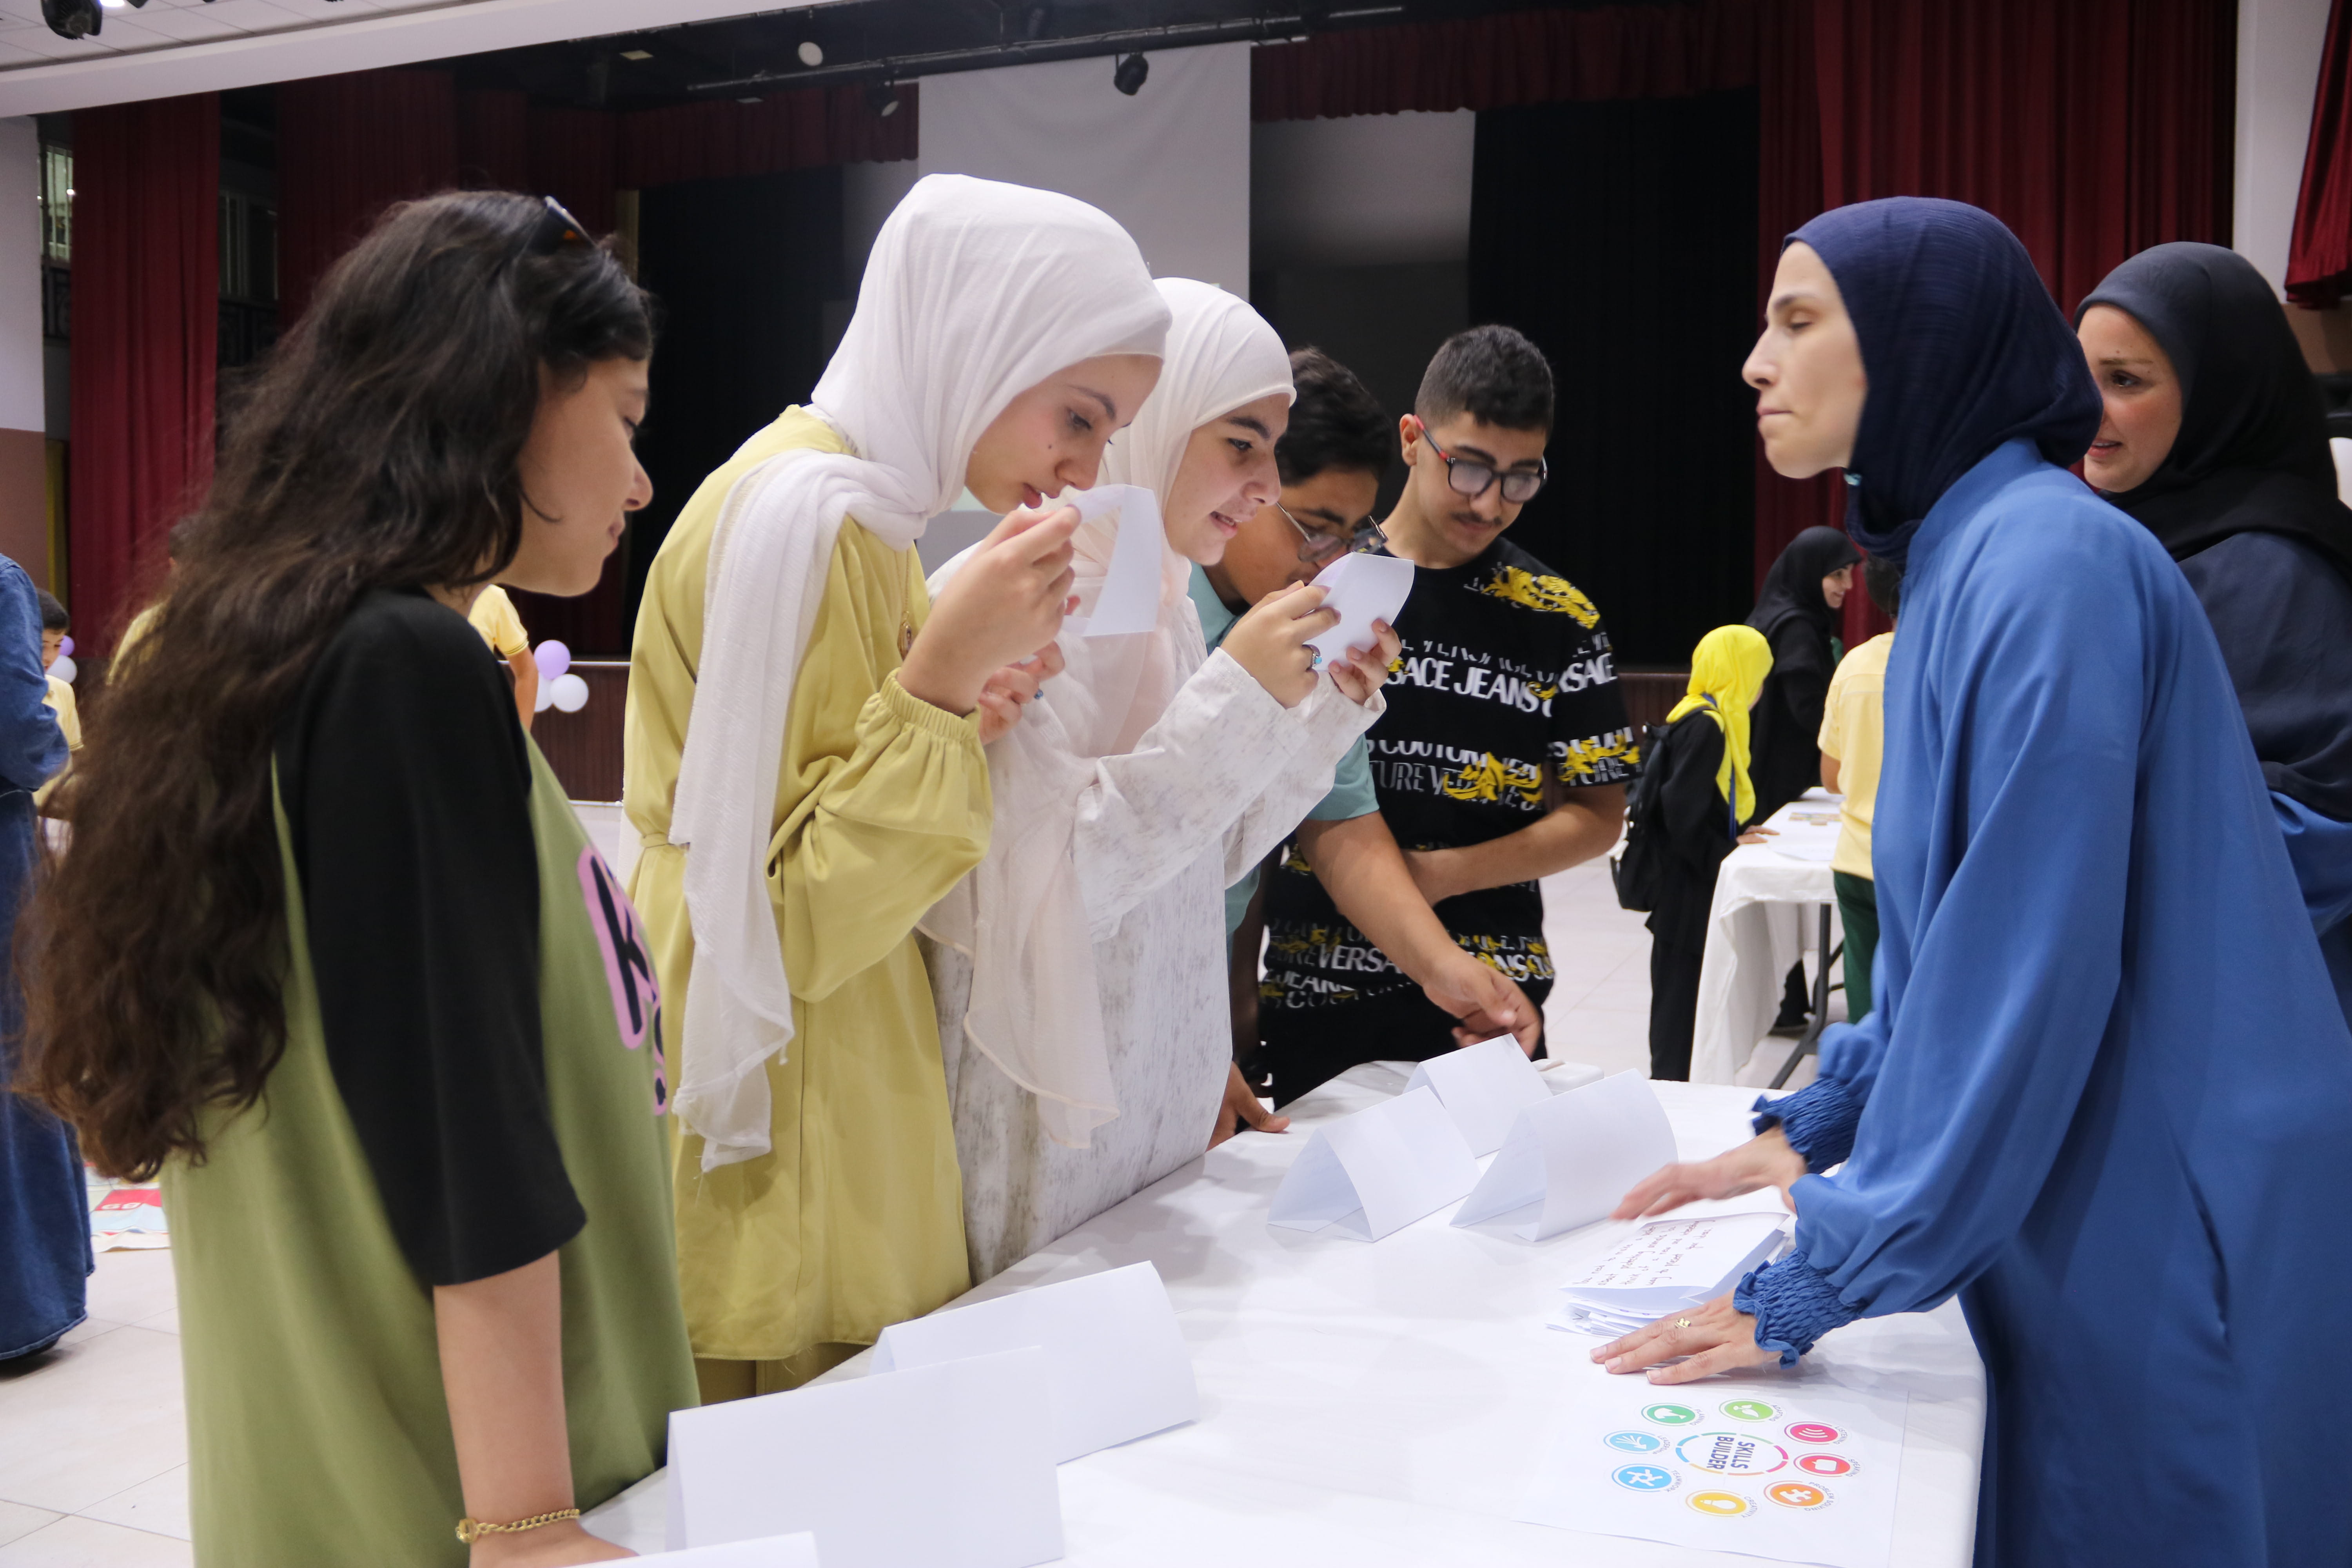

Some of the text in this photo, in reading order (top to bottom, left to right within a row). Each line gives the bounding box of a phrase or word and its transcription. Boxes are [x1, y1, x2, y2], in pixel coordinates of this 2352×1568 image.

[1453, 667, 1539, 712] JEANS
[1591, 1265, 1605, 1274] need
[1615, 1243, 1633, 1255] make
[1646, 1277, 1672, 1286] way
[1664, 1253, 1684, 1267] present
[1597, 1273, 1619, 1285] about
[1619, 1273, 1642, 1285] think
[1689, 1409, 1705, 1426] PLANNING
[1768, 1404, 1783, 1422] ADAPTING
[1652, 1435, 1670, 1455] LEADERSHIP
[1833, 1426, 1847, 1445] LISTENING
[1706, 1436, 1734, 1470] BUILDER
[1730, 1441, 1755, 1469] SKILLS
[1846, 1458, 1861, 1477] SPEAKING
[1667, 1469, 1682, 1492] TEAMWORK
[1740, 1496, 1758, 1518] CREATIVITY
[1804, 1481, 1835, 1512] PROBLEM SOLVING
